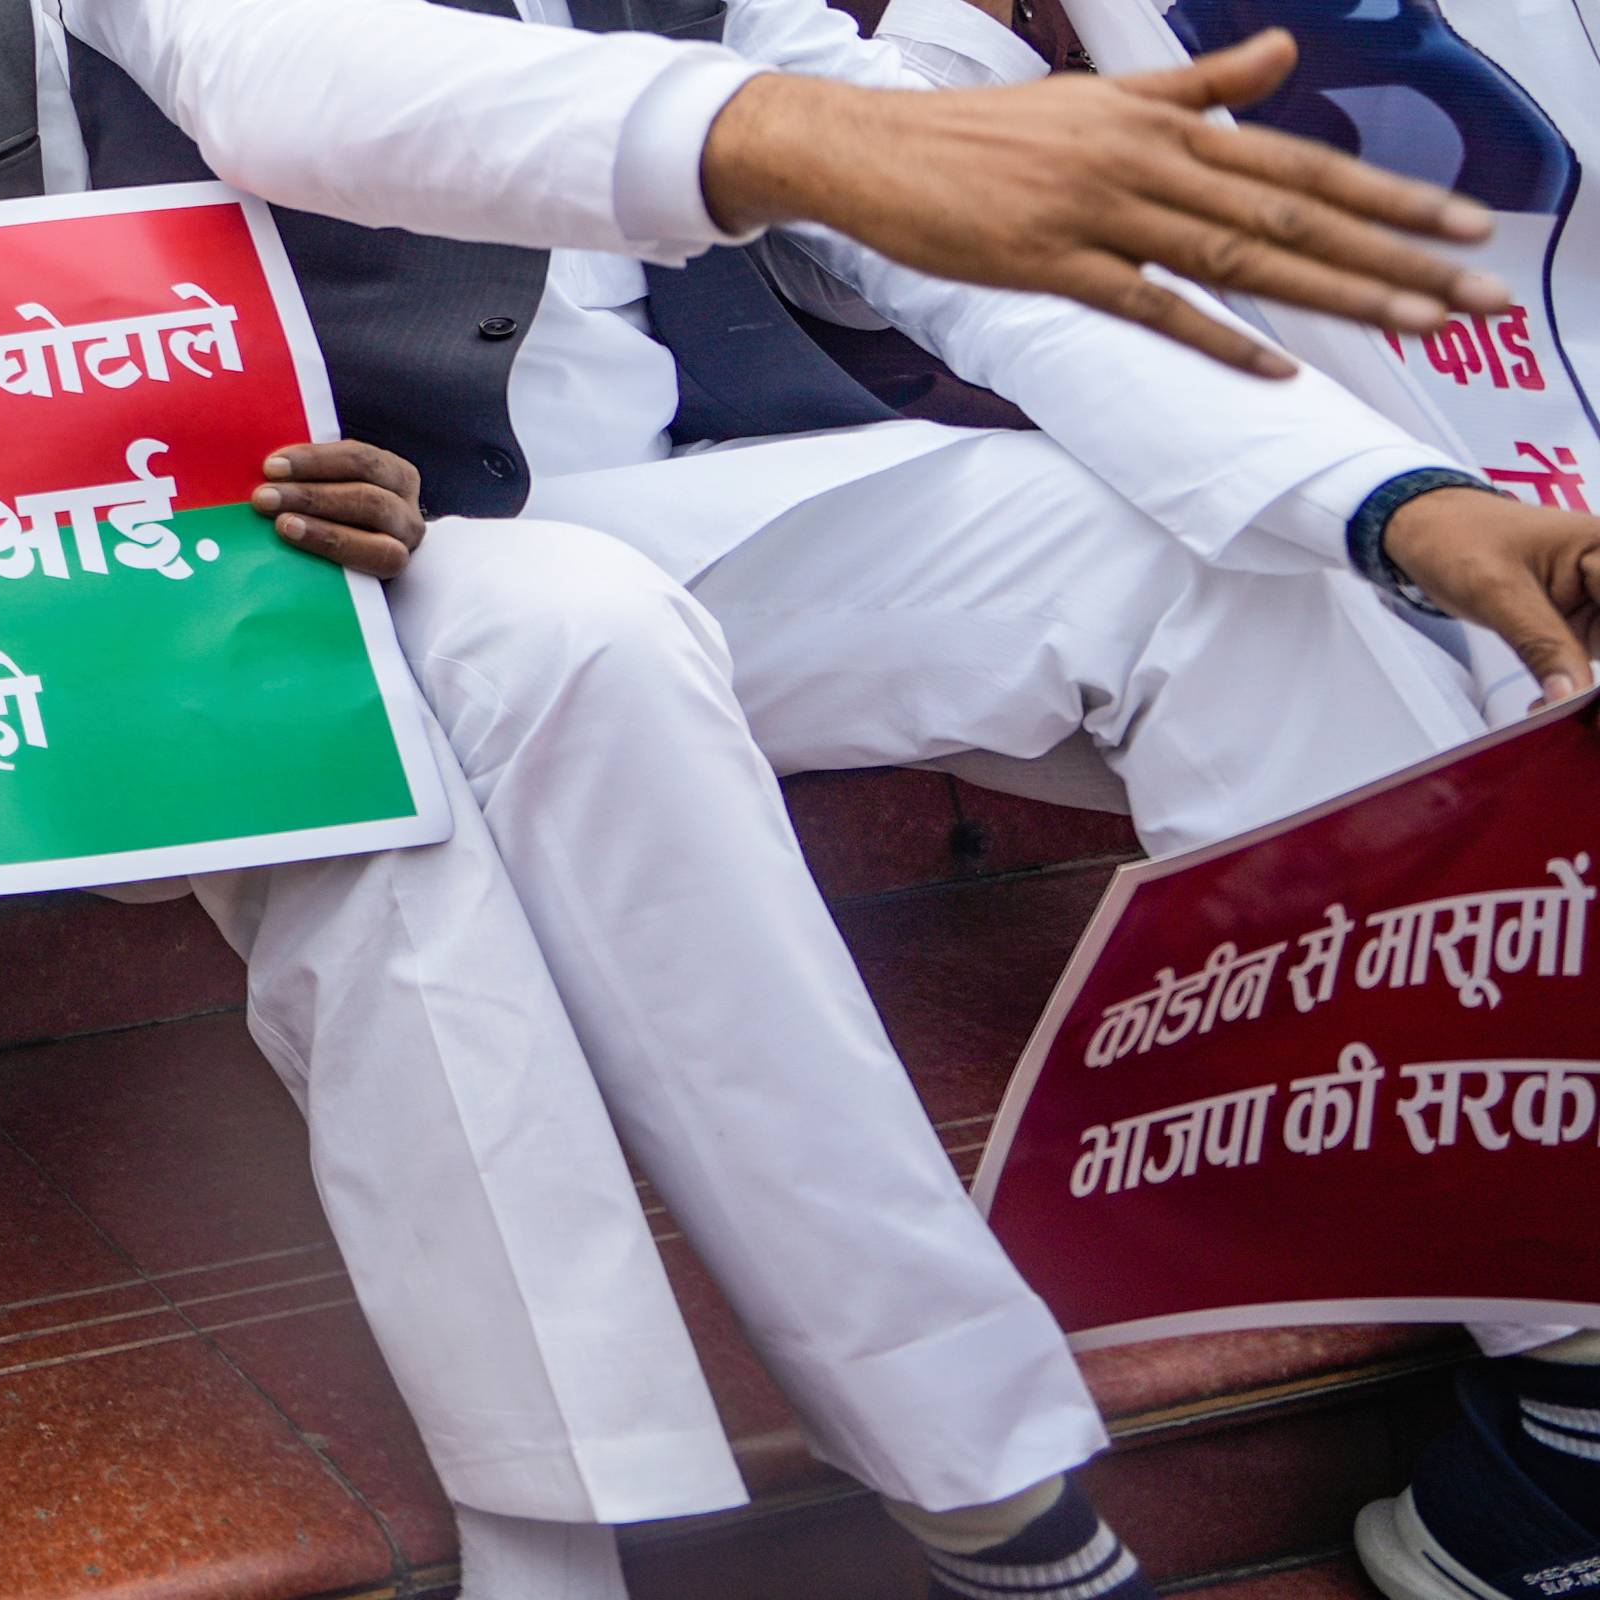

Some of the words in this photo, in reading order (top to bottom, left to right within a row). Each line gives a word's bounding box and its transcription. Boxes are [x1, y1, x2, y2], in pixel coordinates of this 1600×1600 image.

[1085, 942, 1288, 1067] कोडीन
[1288, 904, 1354, 1012] से
[1356, 852, 1596, 1009] मासूमों
[1070, 1084, 1277, 1197] भाजपा
[1284, 1043, 1384, 1155] की
